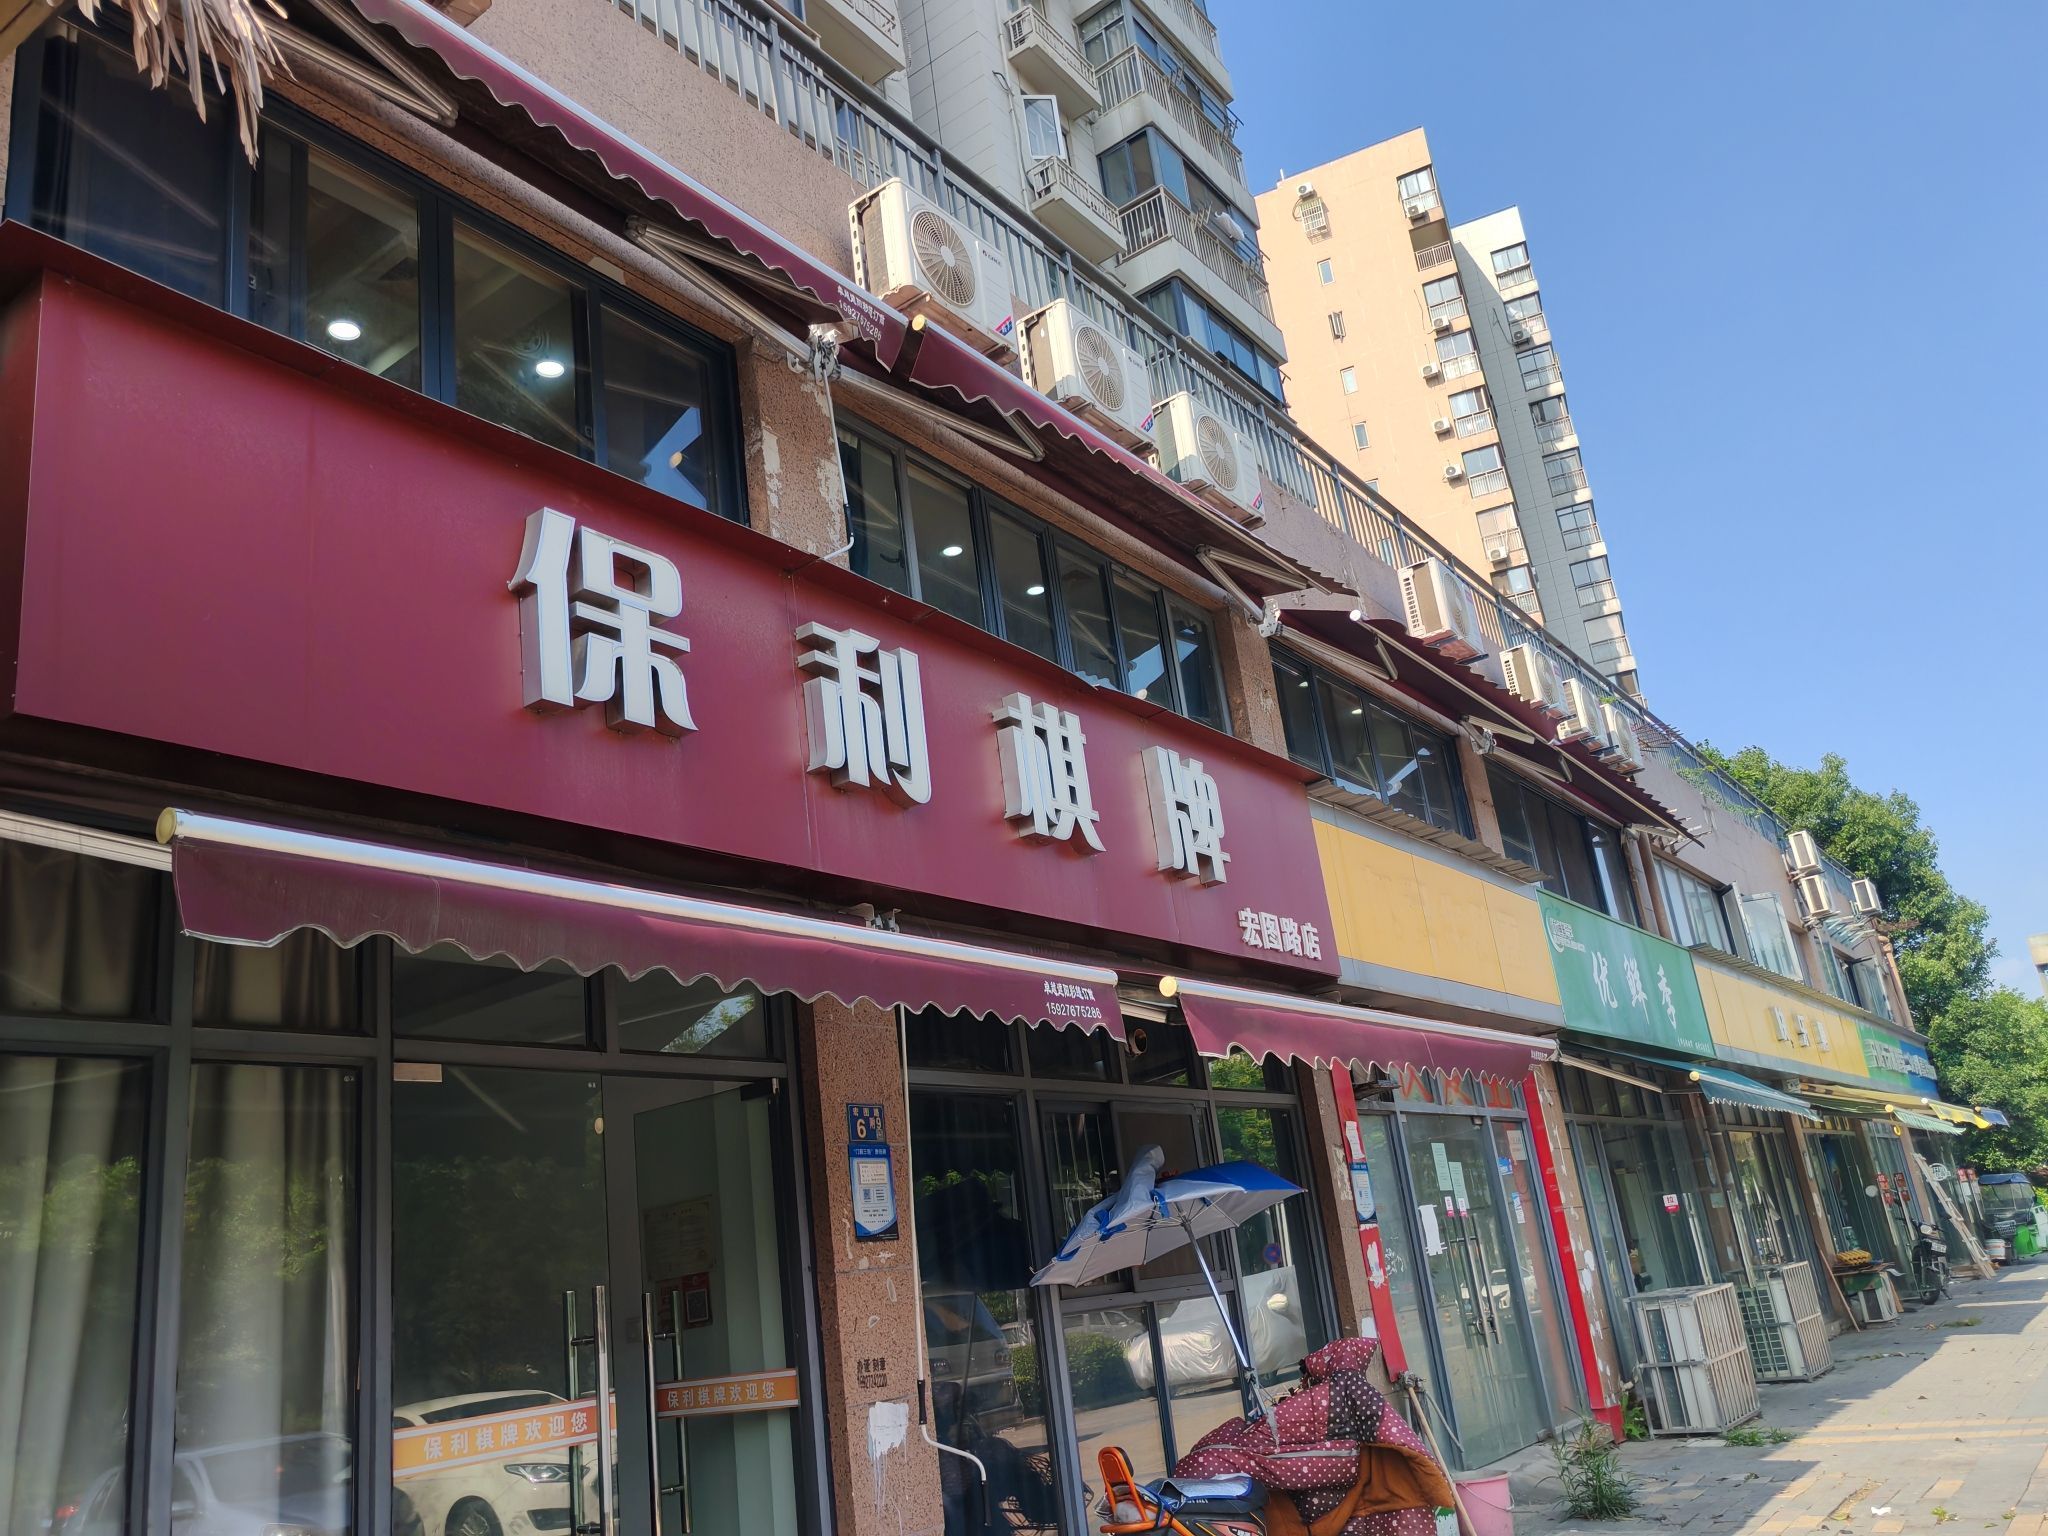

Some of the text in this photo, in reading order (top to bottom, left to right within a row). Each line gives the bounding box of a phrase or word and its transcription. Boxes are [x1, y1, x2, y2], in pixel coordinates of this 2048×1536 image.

[507, 507, 1231, 887] 保利棋牌
[1238, 907, 1322, 960] 宏图路店
[1046, 1001, 1102, 1019] 15927675286
[856, 1118, 867, 1139] 6
[666, 1381, 777, 1409] 保利棋牌欢迎您
[423, 1411, 589, 1461] 保利棋牌欢迎您
